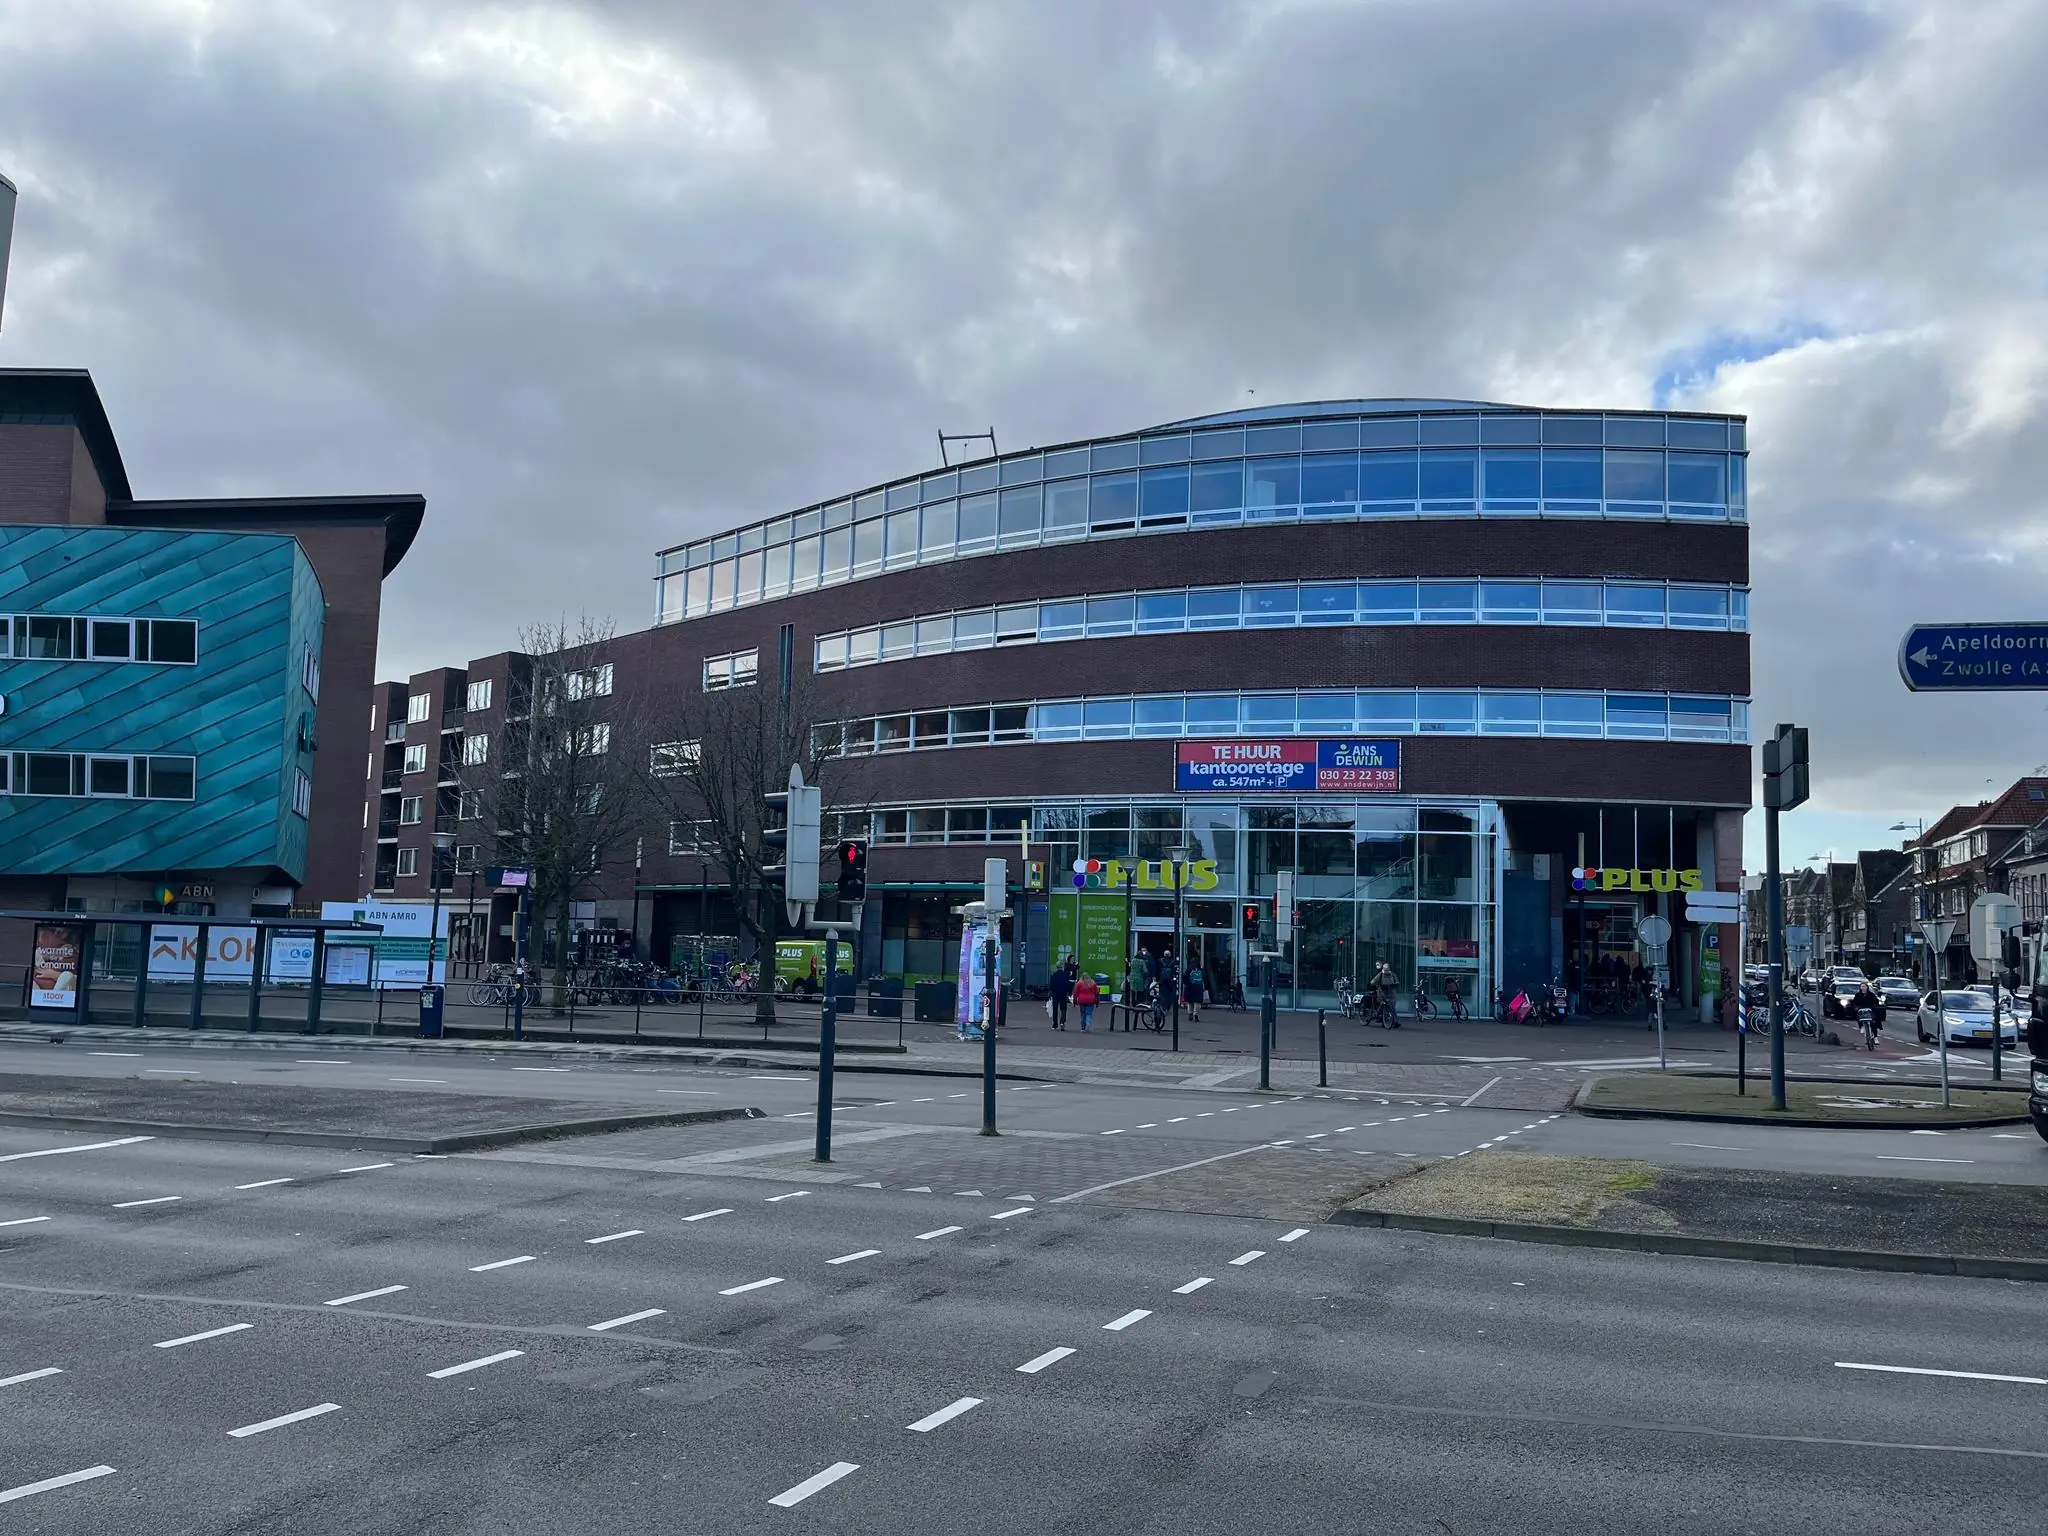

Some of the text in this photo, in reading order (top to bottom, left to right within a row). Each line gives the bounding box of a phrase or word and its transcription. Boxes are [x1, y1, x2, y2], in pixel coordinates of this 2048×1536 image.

[1942, 661, 2012, 675] Zwolle
[1212, 745, 1281, 759] TE HUUR
[1352, 745, 1377, 756] ANS
[1189, 761, 1304, 777] kantooretage
[1320, 770, 1395, 780] 030 23 22 303
[1212, 777, 1228, 787] ca.
[1319, 780, 1396, 789] www.ansdewijn.nl
[1106, 859, 1218, 890] PLUS
[1602, 868, 1704, 893] PLUS
[182, 885, 214, 897] ABN
[1709, 935, 1719, 948] P
[40, 947, 74, 956] warmte
[781, 948, 803, 958] PLUS
[40, 961, 75, 970] omarmt
